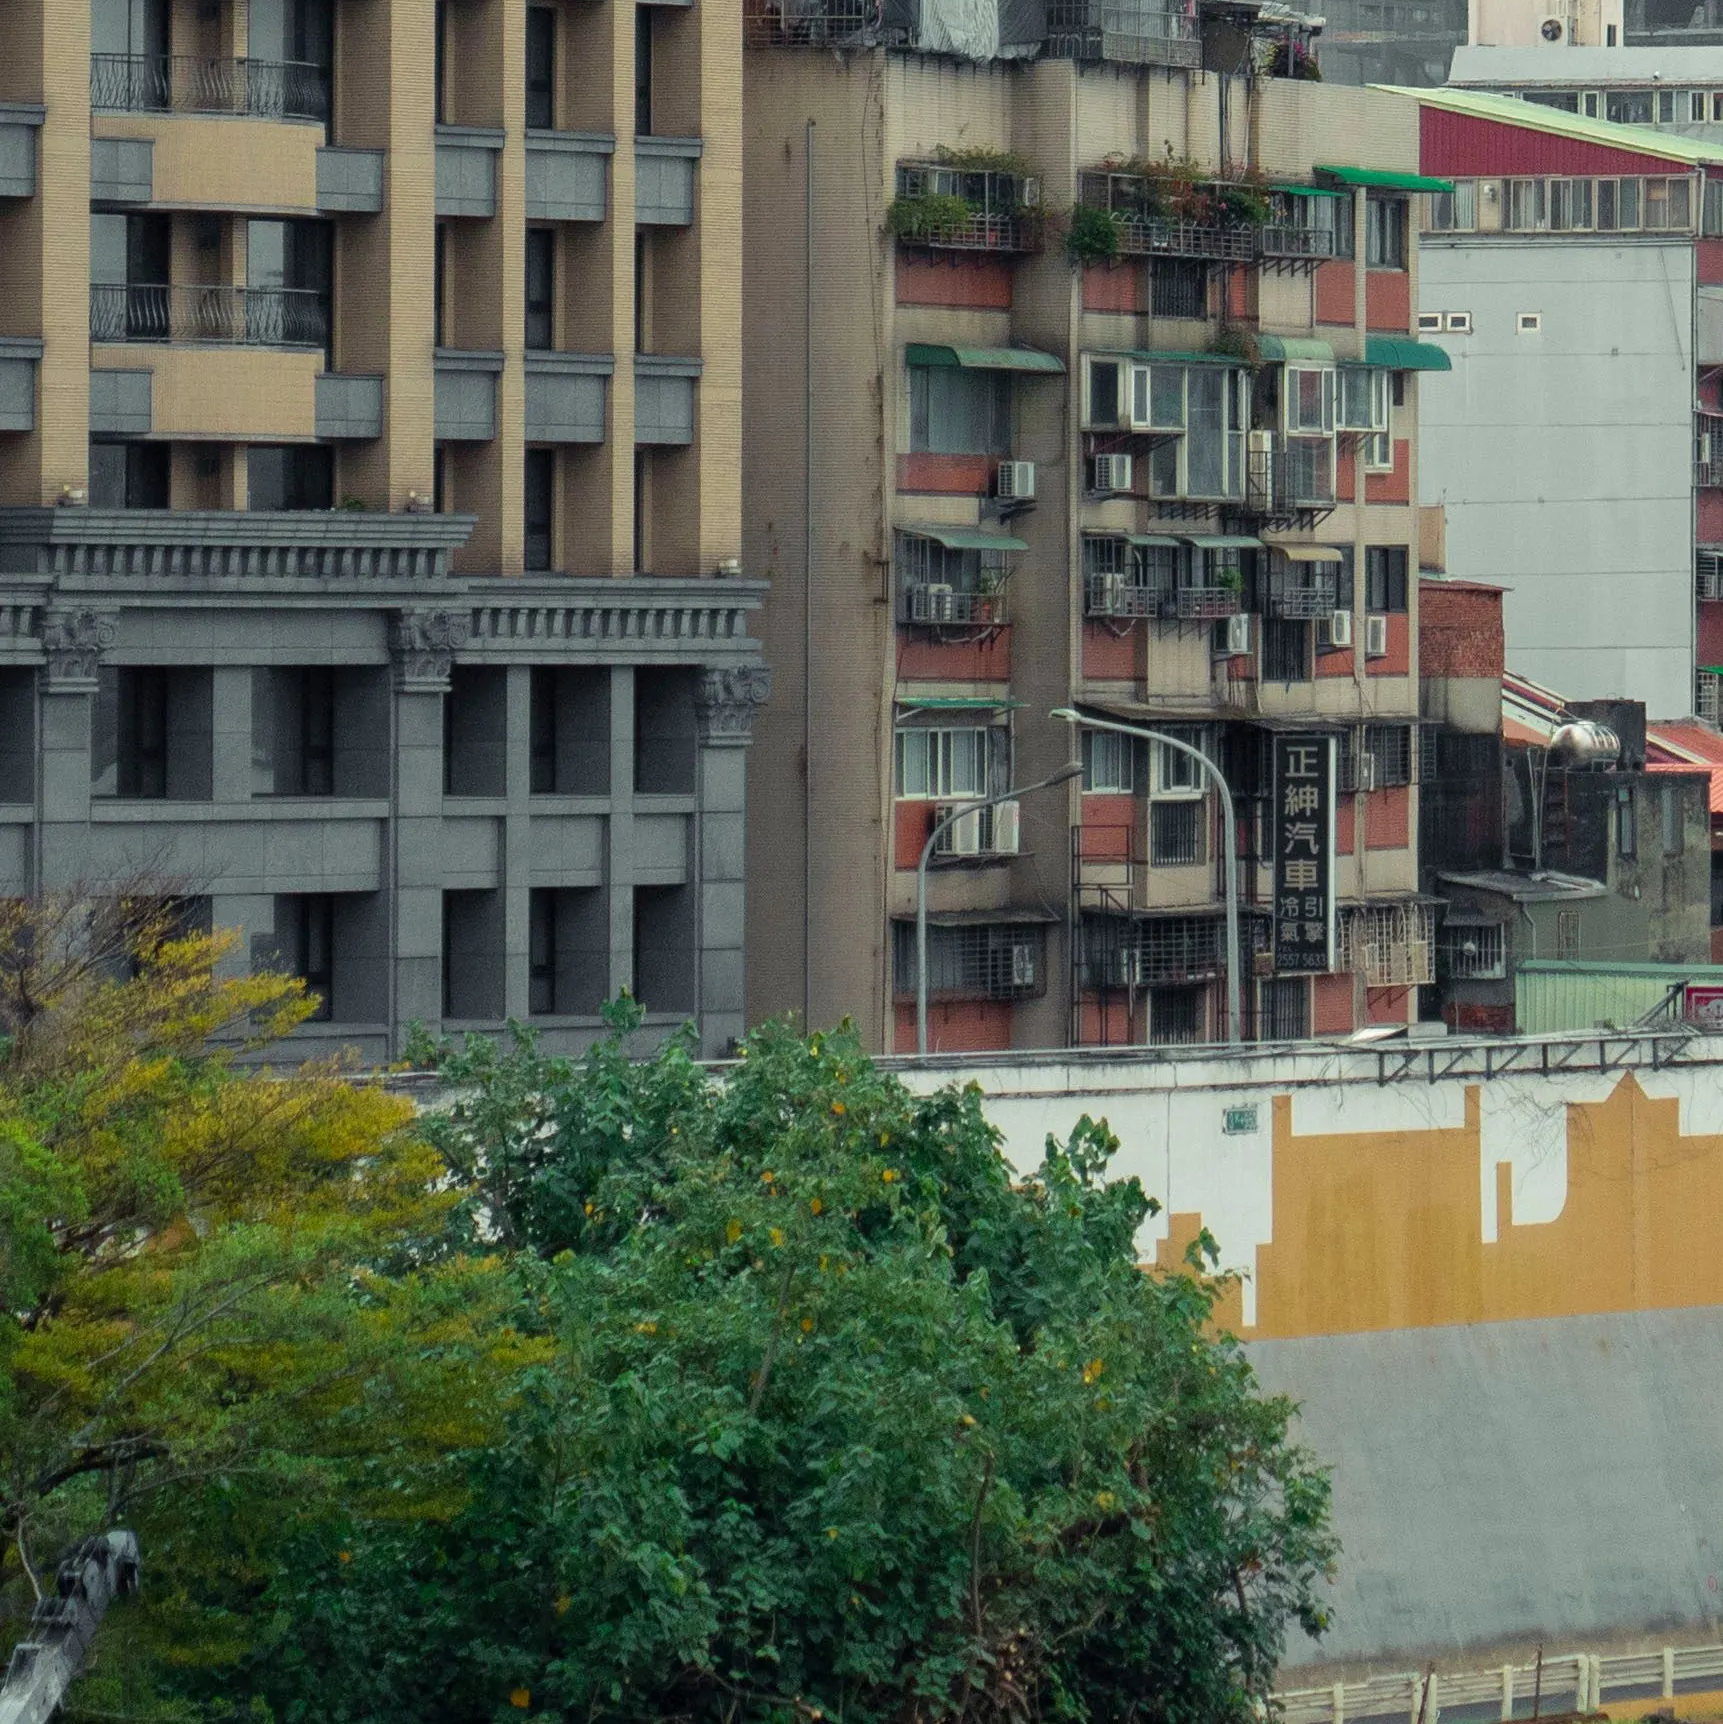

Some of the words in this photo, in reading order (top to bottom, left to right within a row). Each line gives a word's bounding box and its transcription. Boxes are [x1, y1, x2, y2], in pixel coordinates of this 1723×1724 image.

[1284, 745, 1320, 892] 正紳汽車
[1280, 896, 1301, 943] 冷氣
[1304, 896, 1325, 943] 引擎
